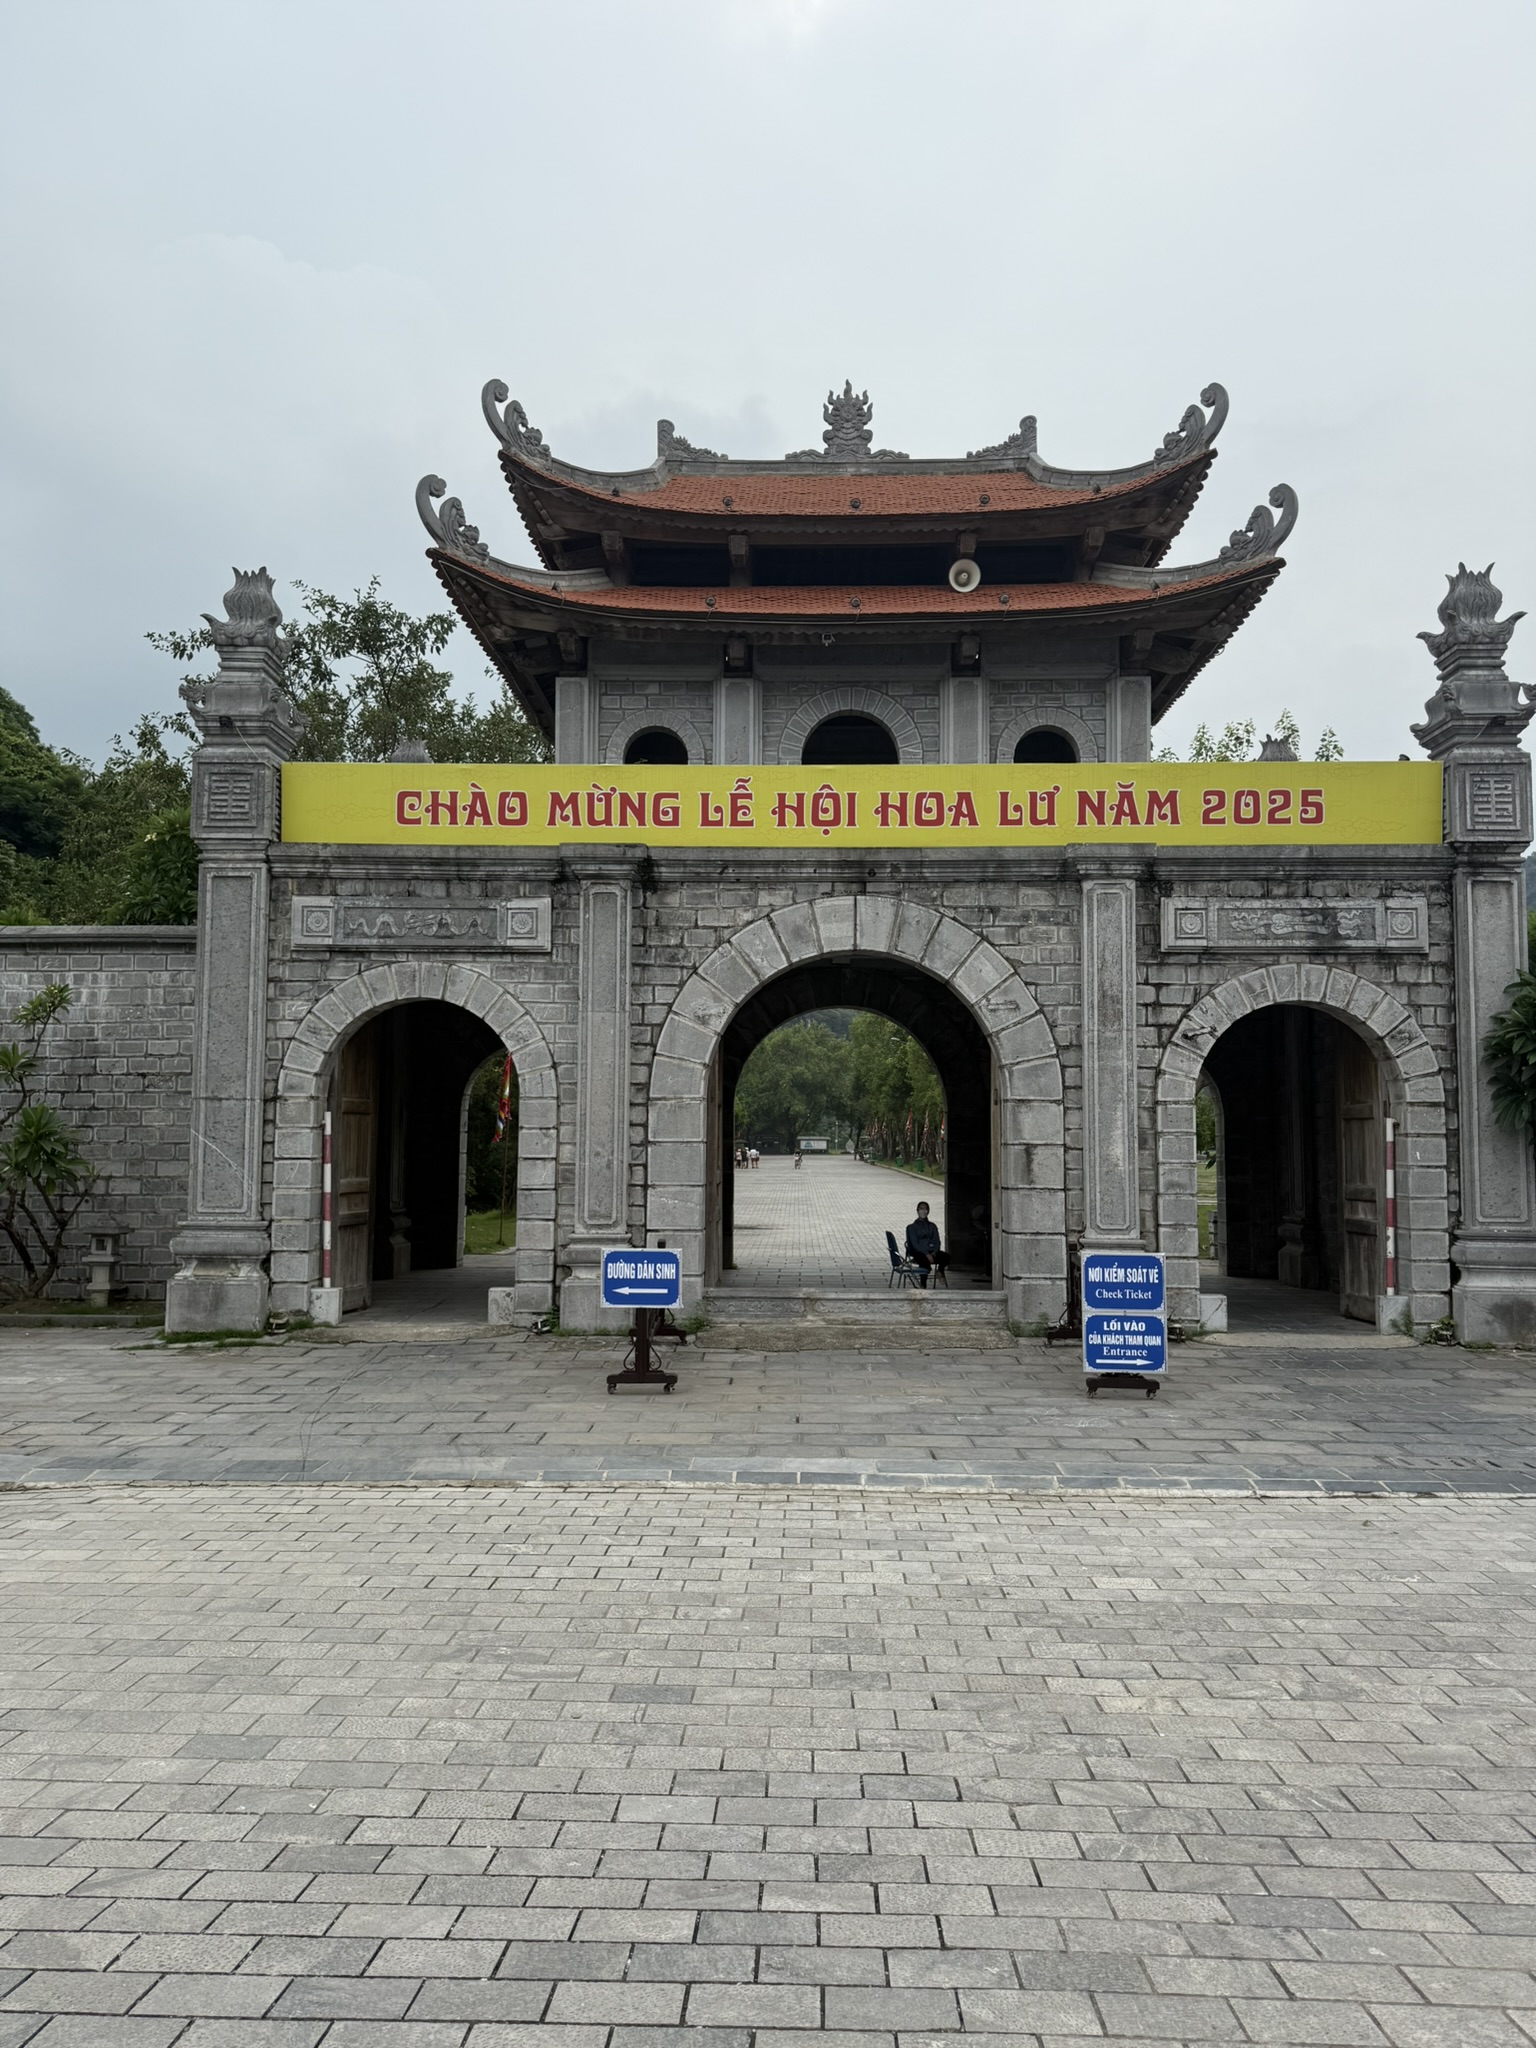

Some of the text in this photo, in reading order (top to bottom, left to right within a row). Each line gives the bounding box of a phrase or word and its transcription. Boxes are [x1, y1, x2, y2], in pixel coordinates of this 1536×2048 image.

[396, 776, 1326, 837] CHÀO MỪNG LỄ HỘI HOA LƯ NĂM 2025
[607, 1259, 676, 1279] ĐƯỜNG DÂN SINH
[1088, 1262, 1159, 1283] NƠI KIỂM SOÁT VÉ
[1095, 1288, 1152, 1299] Check Ticket
[1103, 1318, 1146, 1331] LỐI VÀO
[1088, 1331, 1162, 1347] CỦA KHÁCH THAM QUAN
[1103, 1346, 1148, 1356] Entrance
